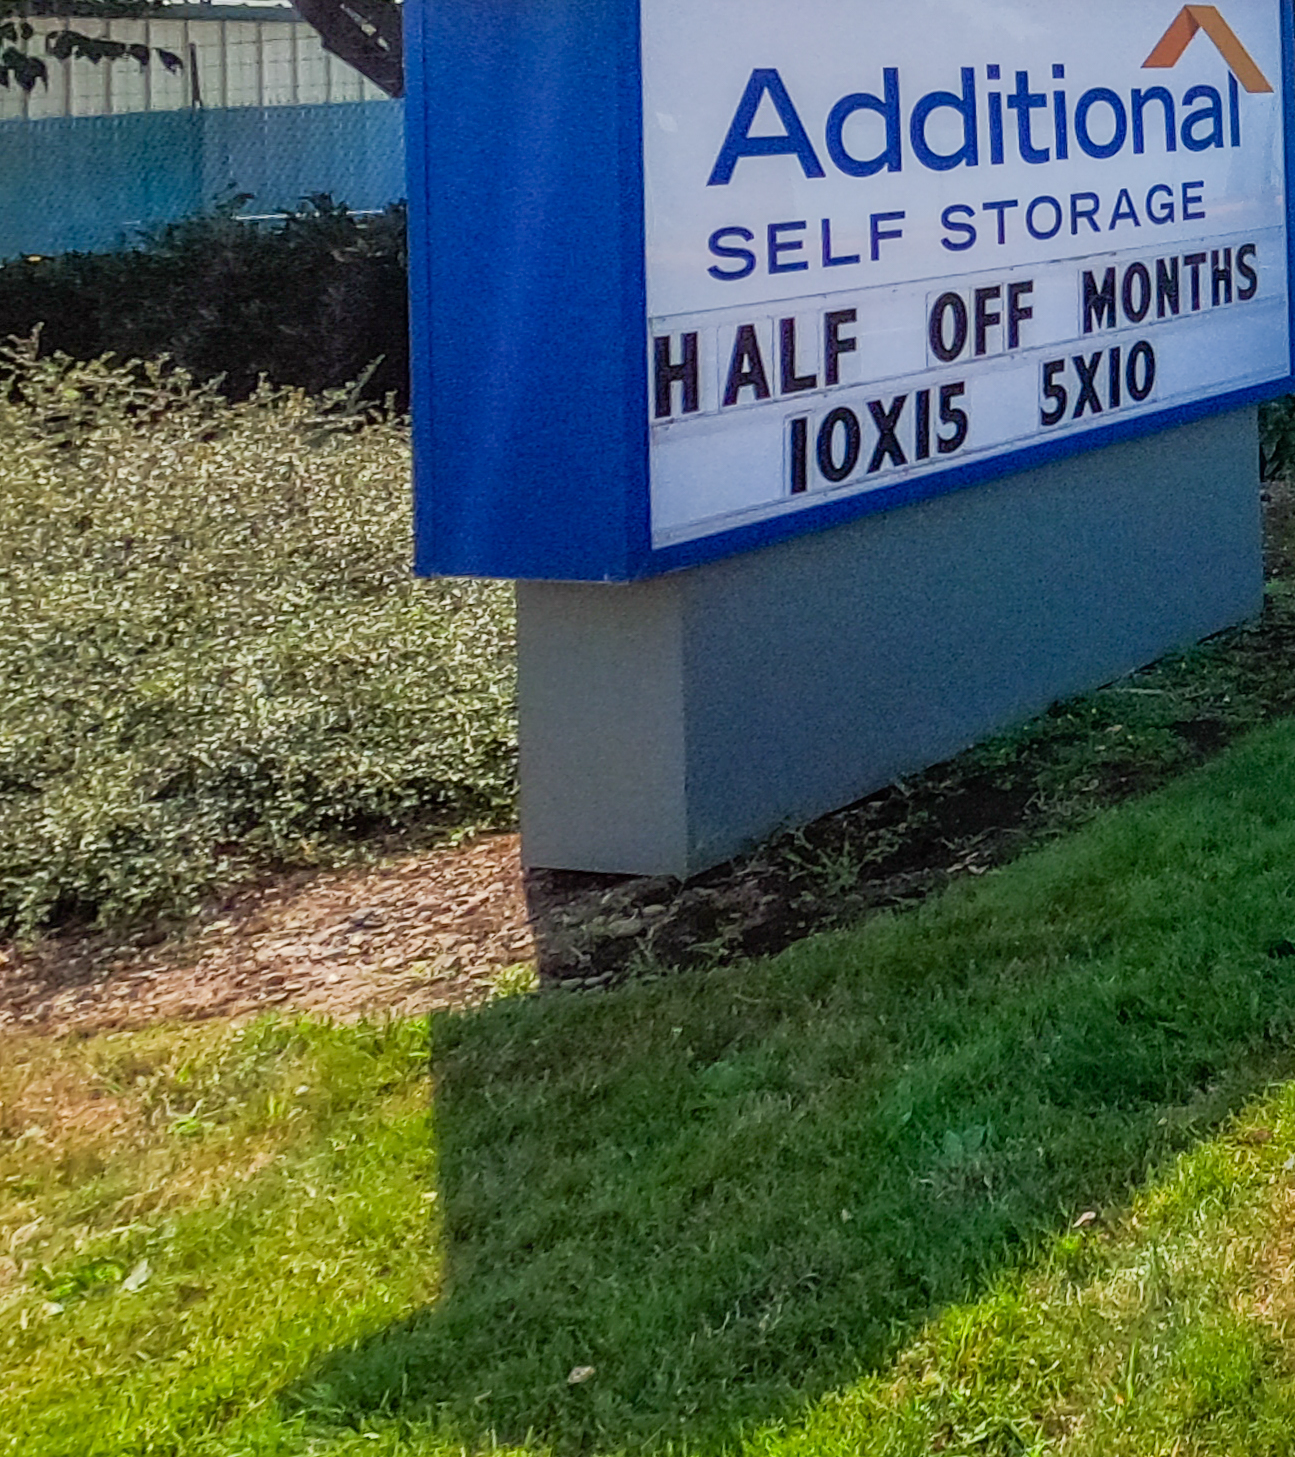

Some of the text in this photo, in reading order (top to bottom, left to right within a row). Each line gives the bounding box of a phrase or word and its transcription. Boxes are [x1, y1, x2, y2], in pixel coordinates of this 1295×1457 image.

[705, 63, 1242, 186] Additional
[707, 180, 1207, 281] SELF STORAGE
[652, 243, 1259, 419] HALF OFF MONTHS
[789, 339, 1156, 495] 10X15 5X10
